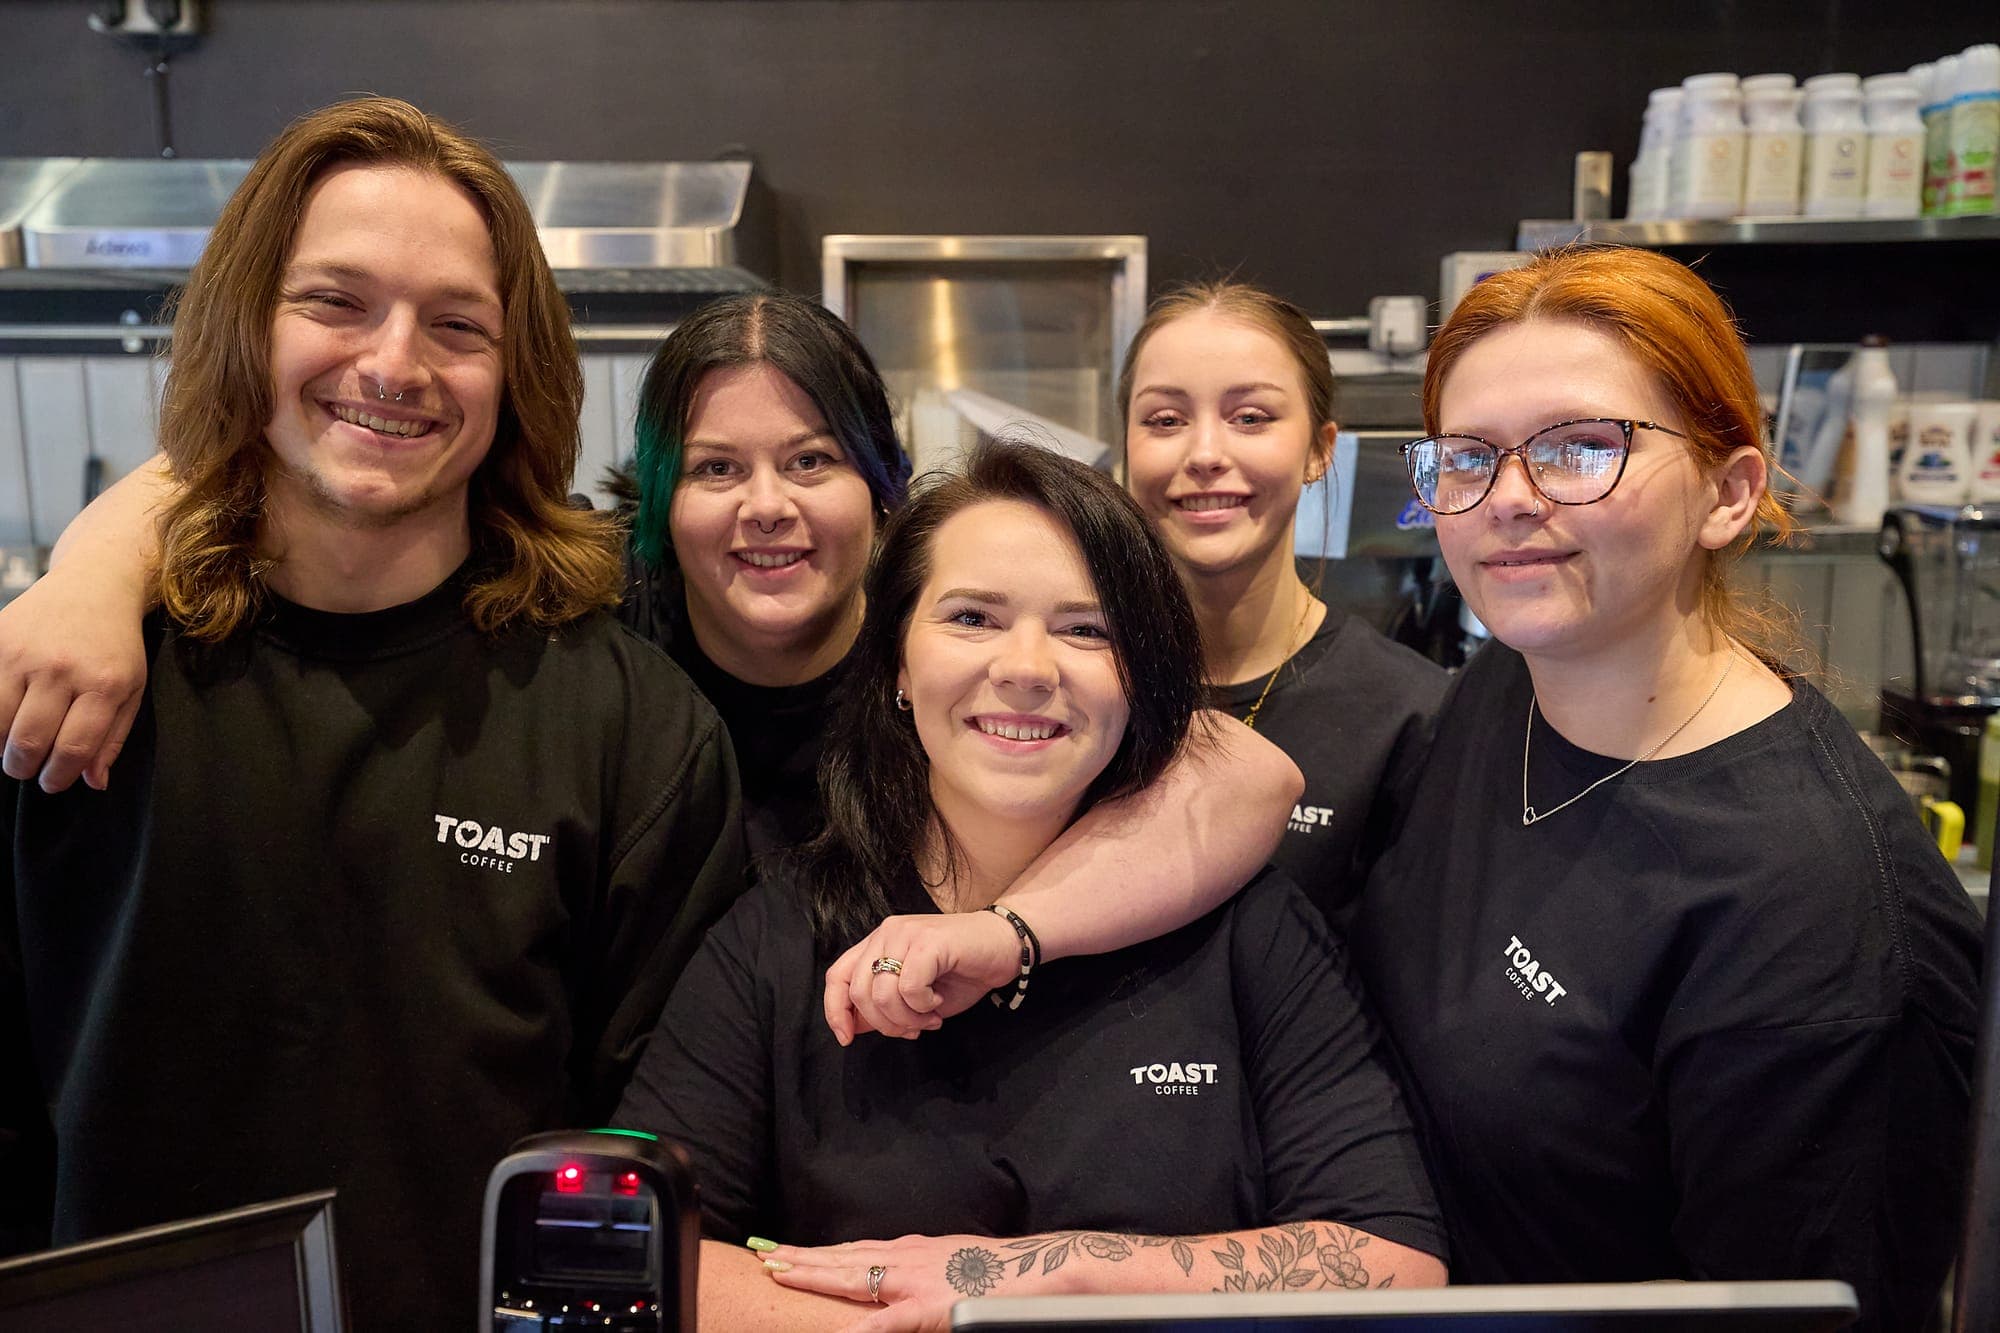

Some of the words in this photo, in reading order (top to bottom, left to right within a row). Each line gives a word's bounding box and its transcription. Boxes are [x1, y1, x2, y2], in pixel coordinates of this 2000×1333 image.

[1287, 821, 1312, 834] FFEE
[460, 852, 513, 873] COFFEE
[1505, 967, 1535, 1001] COFFEE
[1155, 1085, 1199, 1095] COFFEE
